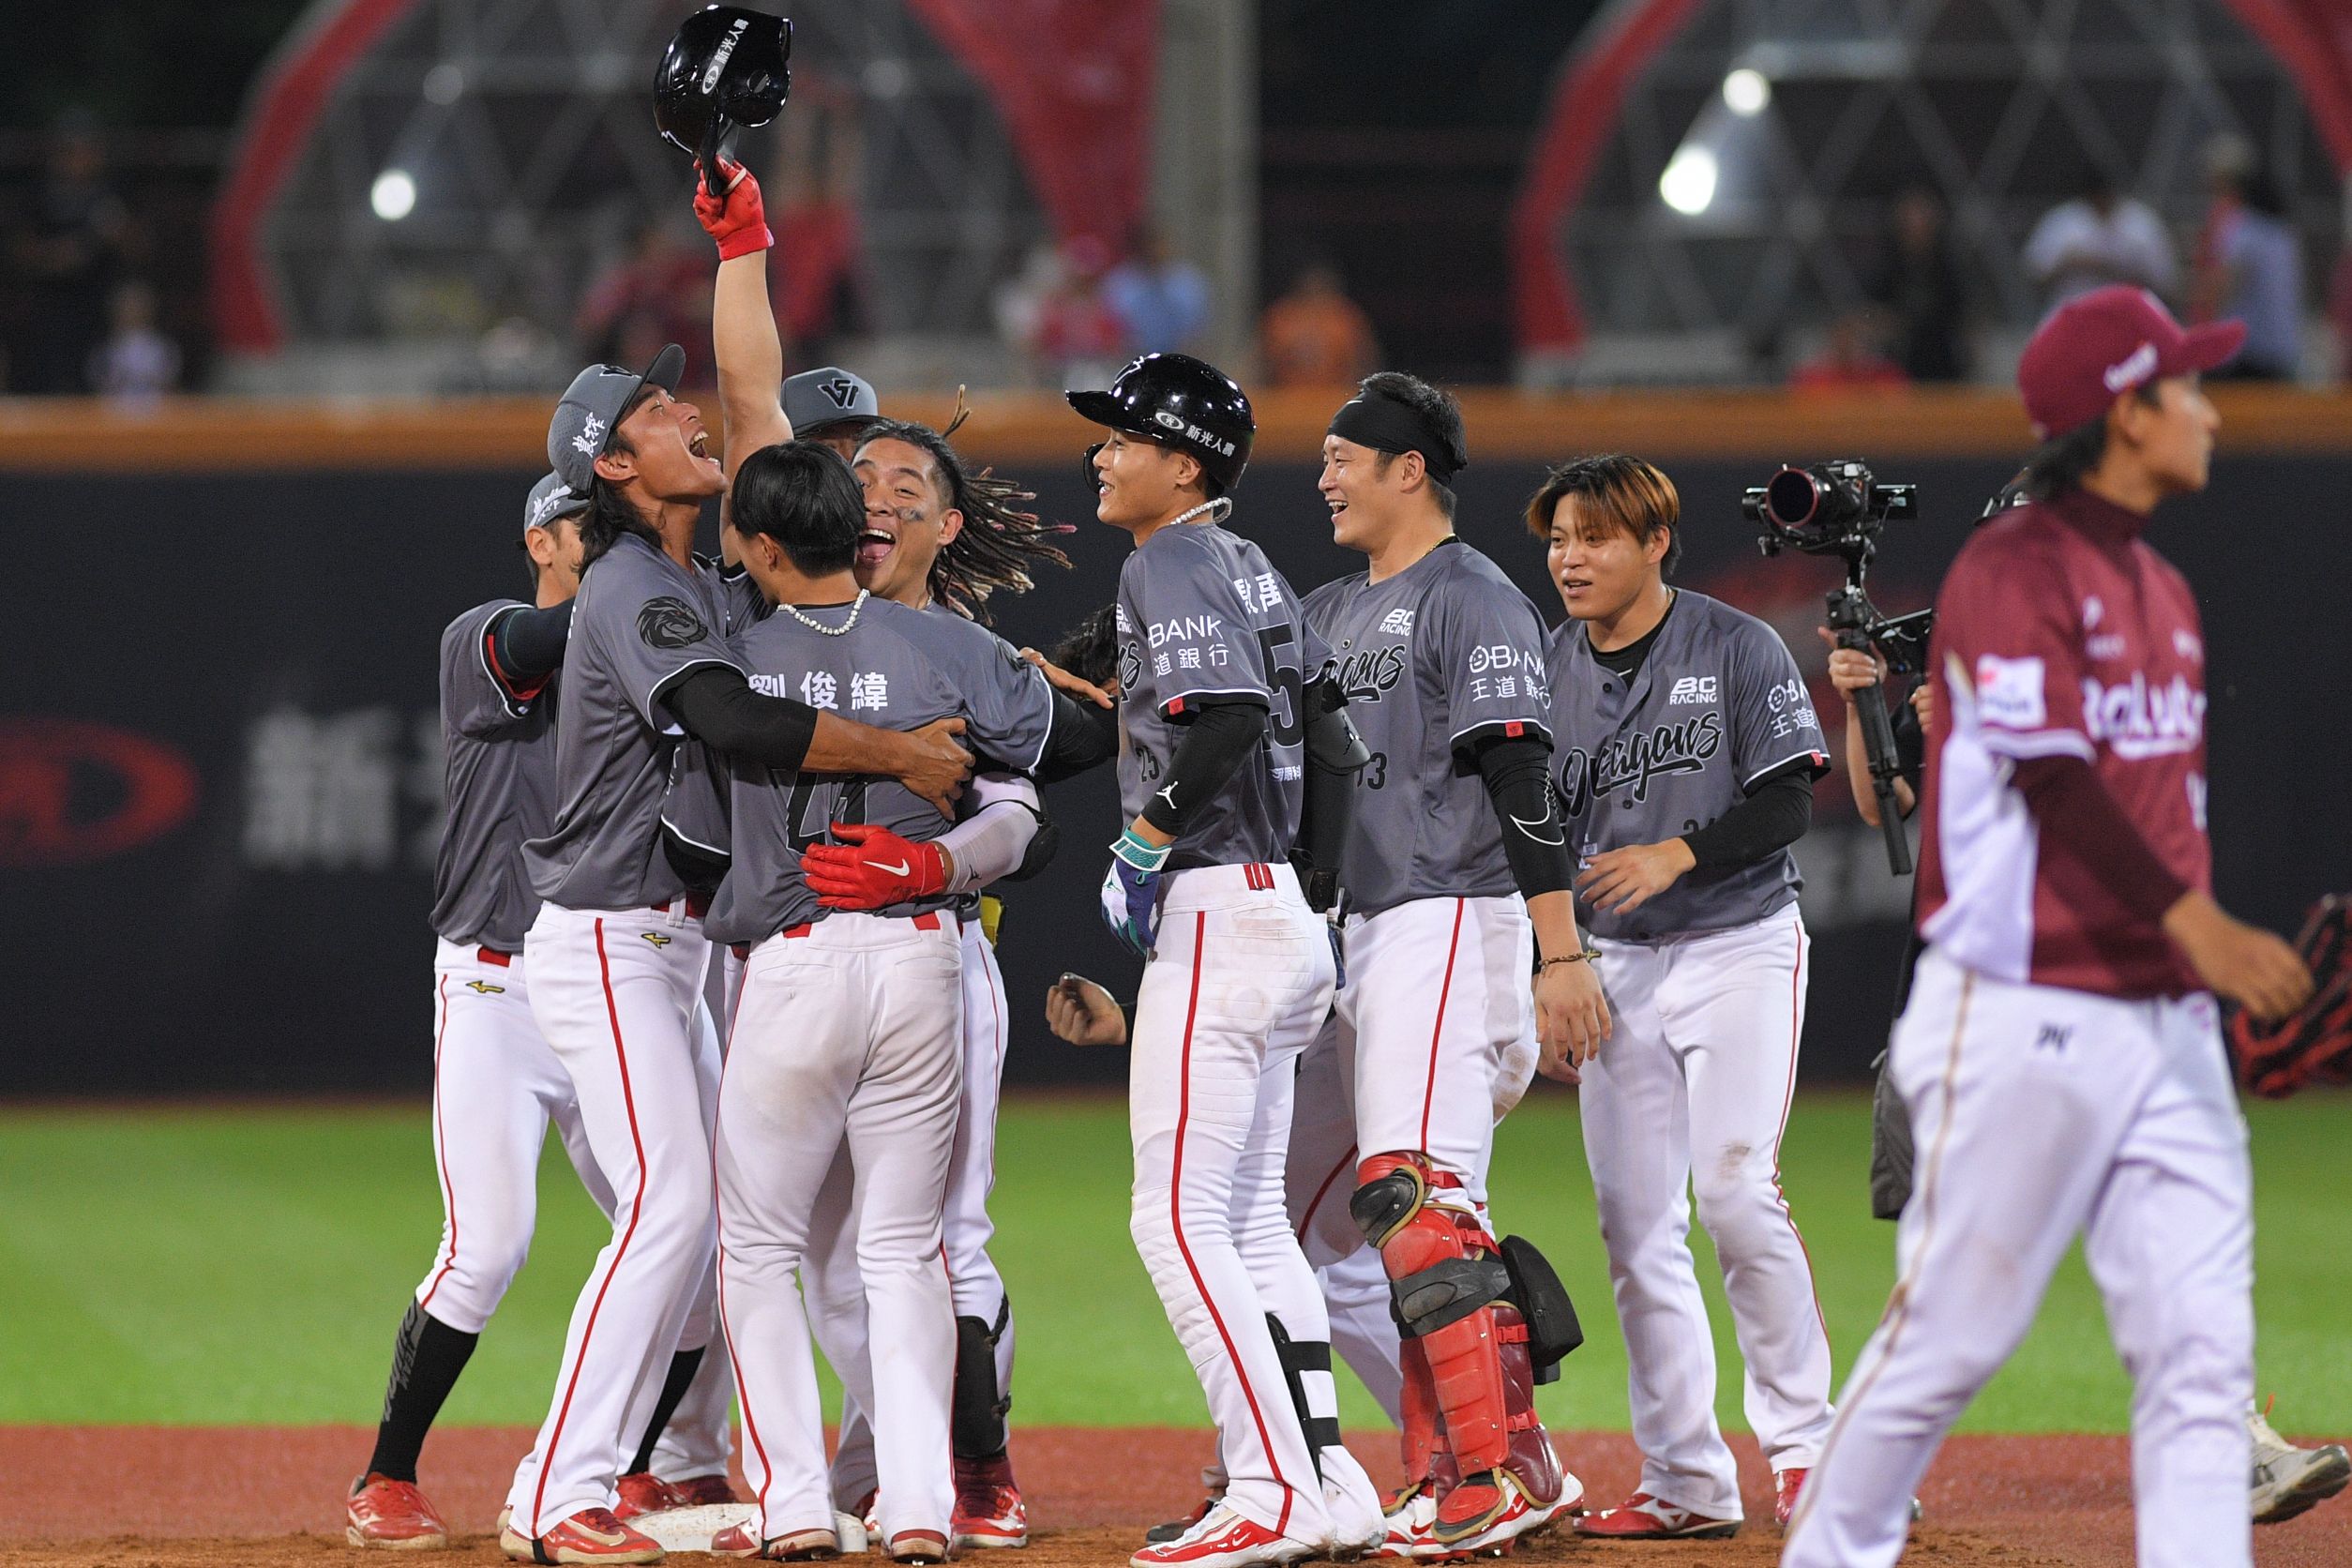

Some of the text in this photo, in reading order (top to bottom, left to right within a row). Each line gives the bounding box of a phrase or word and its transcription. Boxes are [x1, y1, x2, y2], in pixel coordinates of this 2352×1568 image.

[1185, 424, 1236, 458] 新光人壽
[1383, 608, 1414, 626] BC
[1378, 622, 1411, 637] RACING
[747, 671, 889, 711] 劉俊緯
[1672, 675, 1717, 694] BC
[1669, 693, 1718, 705] RACING
